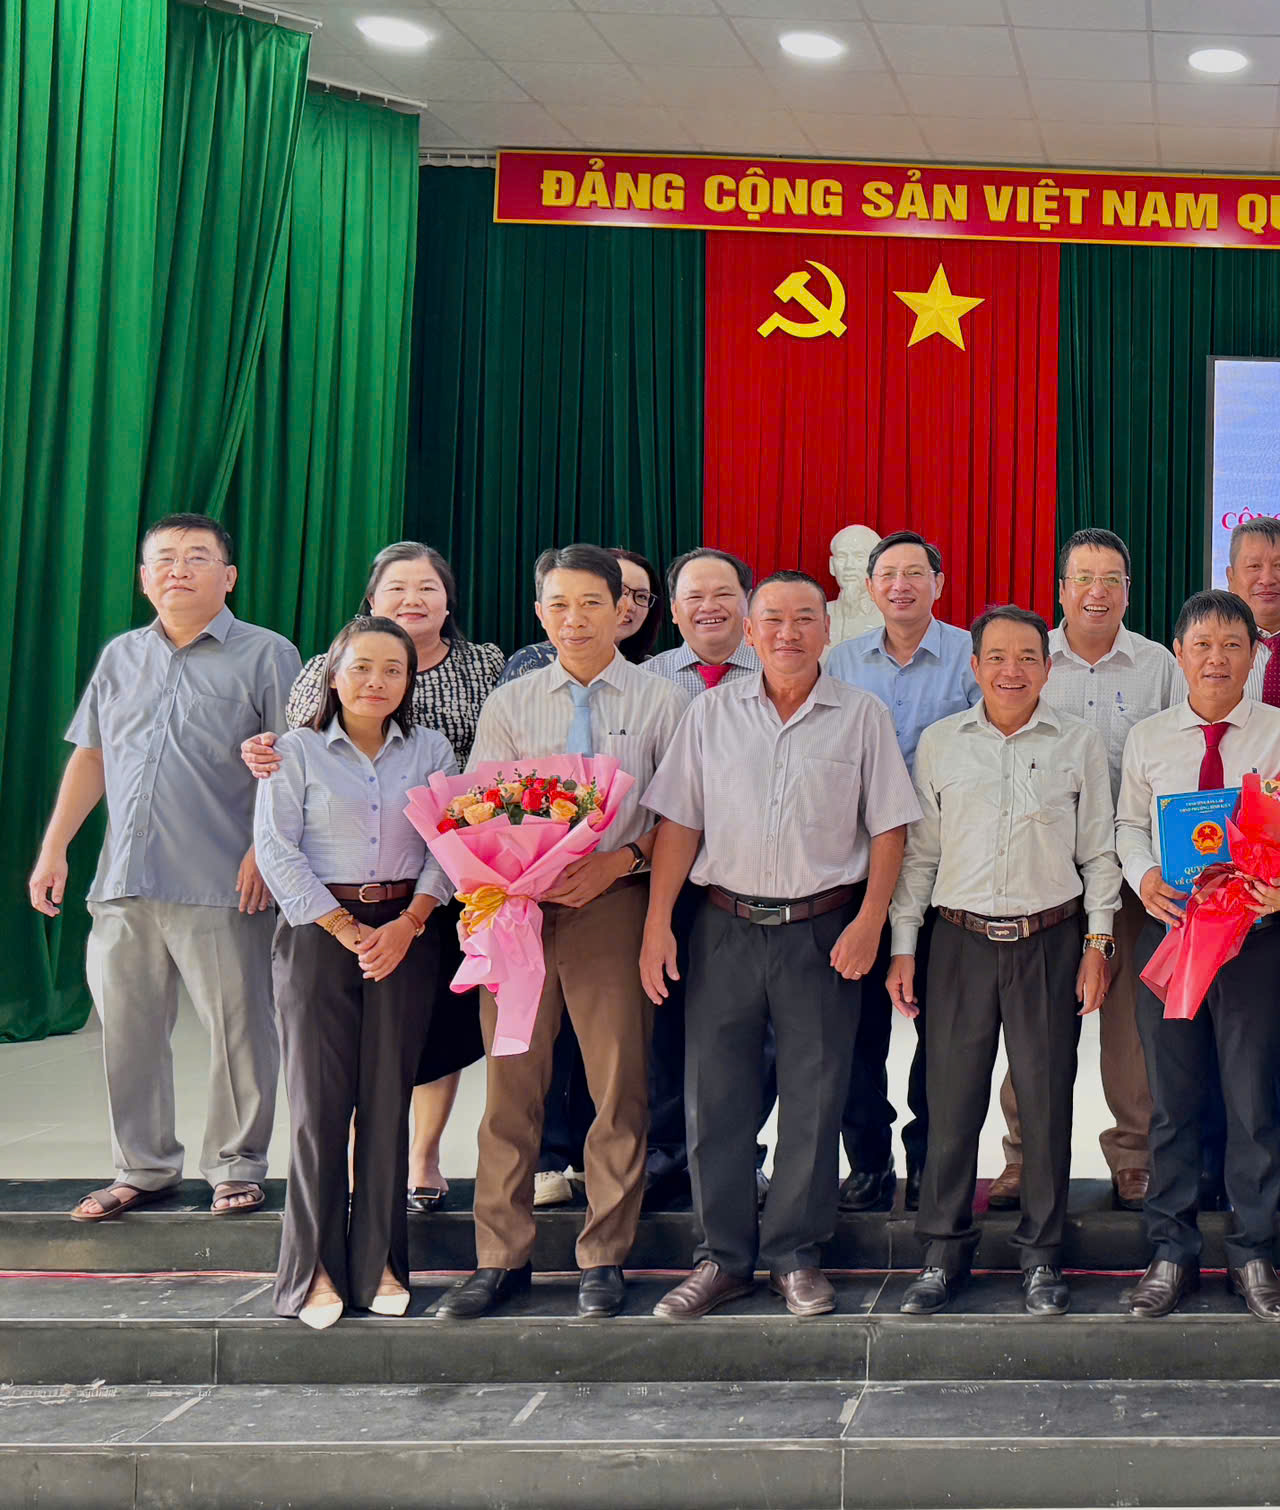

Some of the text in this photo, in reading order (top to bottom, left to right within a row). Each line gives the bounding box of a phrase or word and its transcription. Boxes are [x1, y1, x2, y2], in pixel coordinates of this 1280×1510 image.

[540, 157, 686, 212] ĐẢNG
[703, 166, 844, 221] CỘNG
[861, 168, 969, 222] SẢN
[982, 178, 1091, 231] VIỆT
[1102, 189, 1219, 230] NAM
